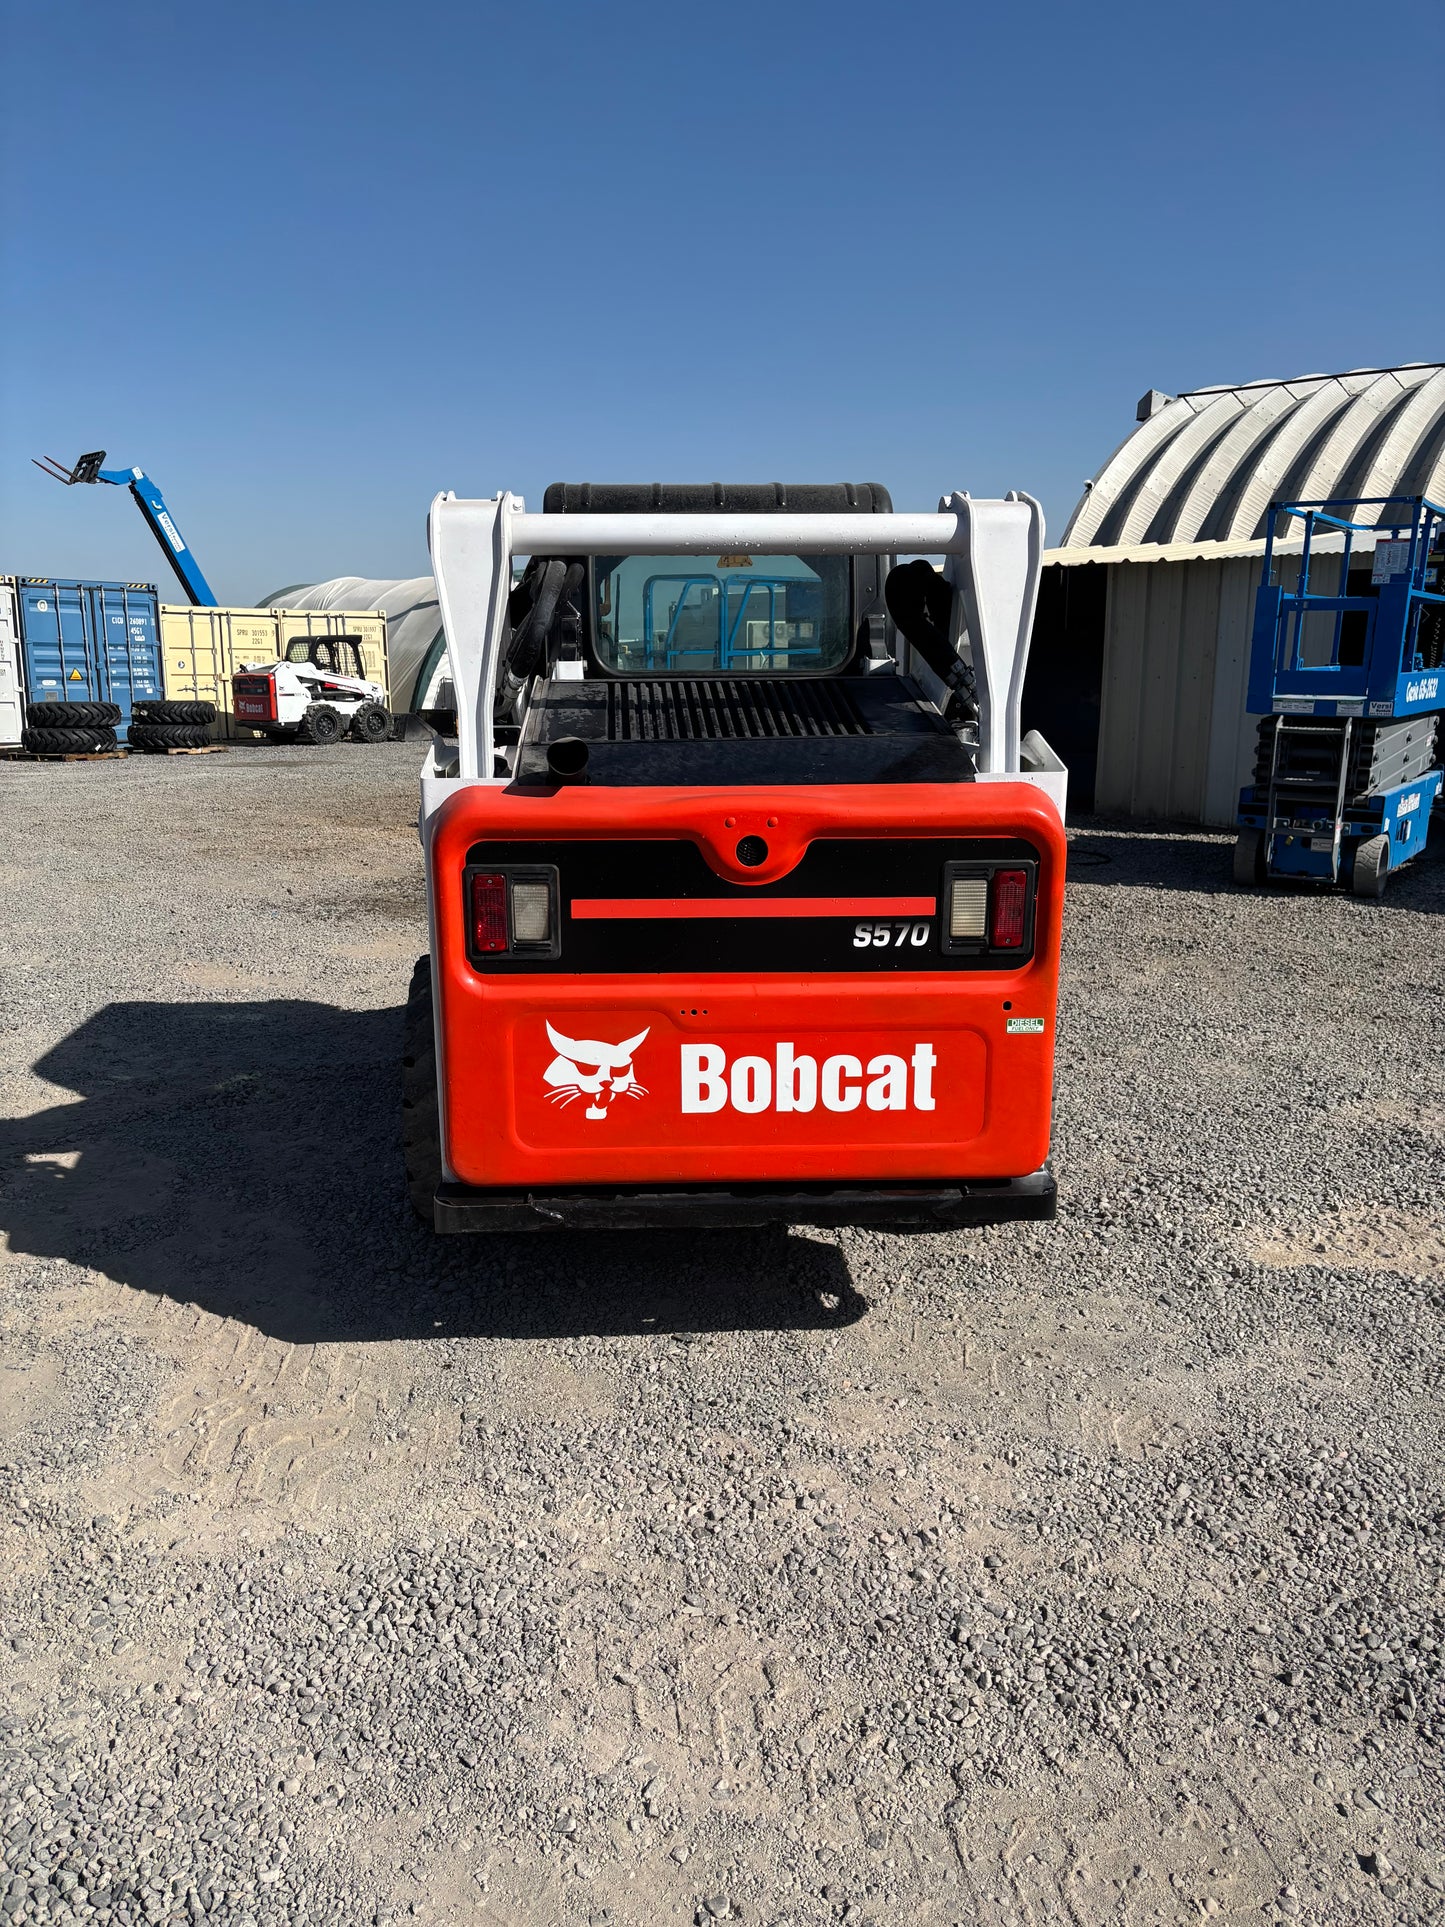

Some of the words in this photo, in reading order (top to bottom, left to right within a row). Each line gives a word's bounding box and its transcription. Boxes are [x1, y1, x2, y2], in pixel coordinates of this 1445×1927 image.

[246, 702, 264, 714] Bobcat
[852, 921, 931, 949] S570
[1012, 1018, 1041, 1027] DIESEL
[680, 1041, 938, 1115] Bobcat
